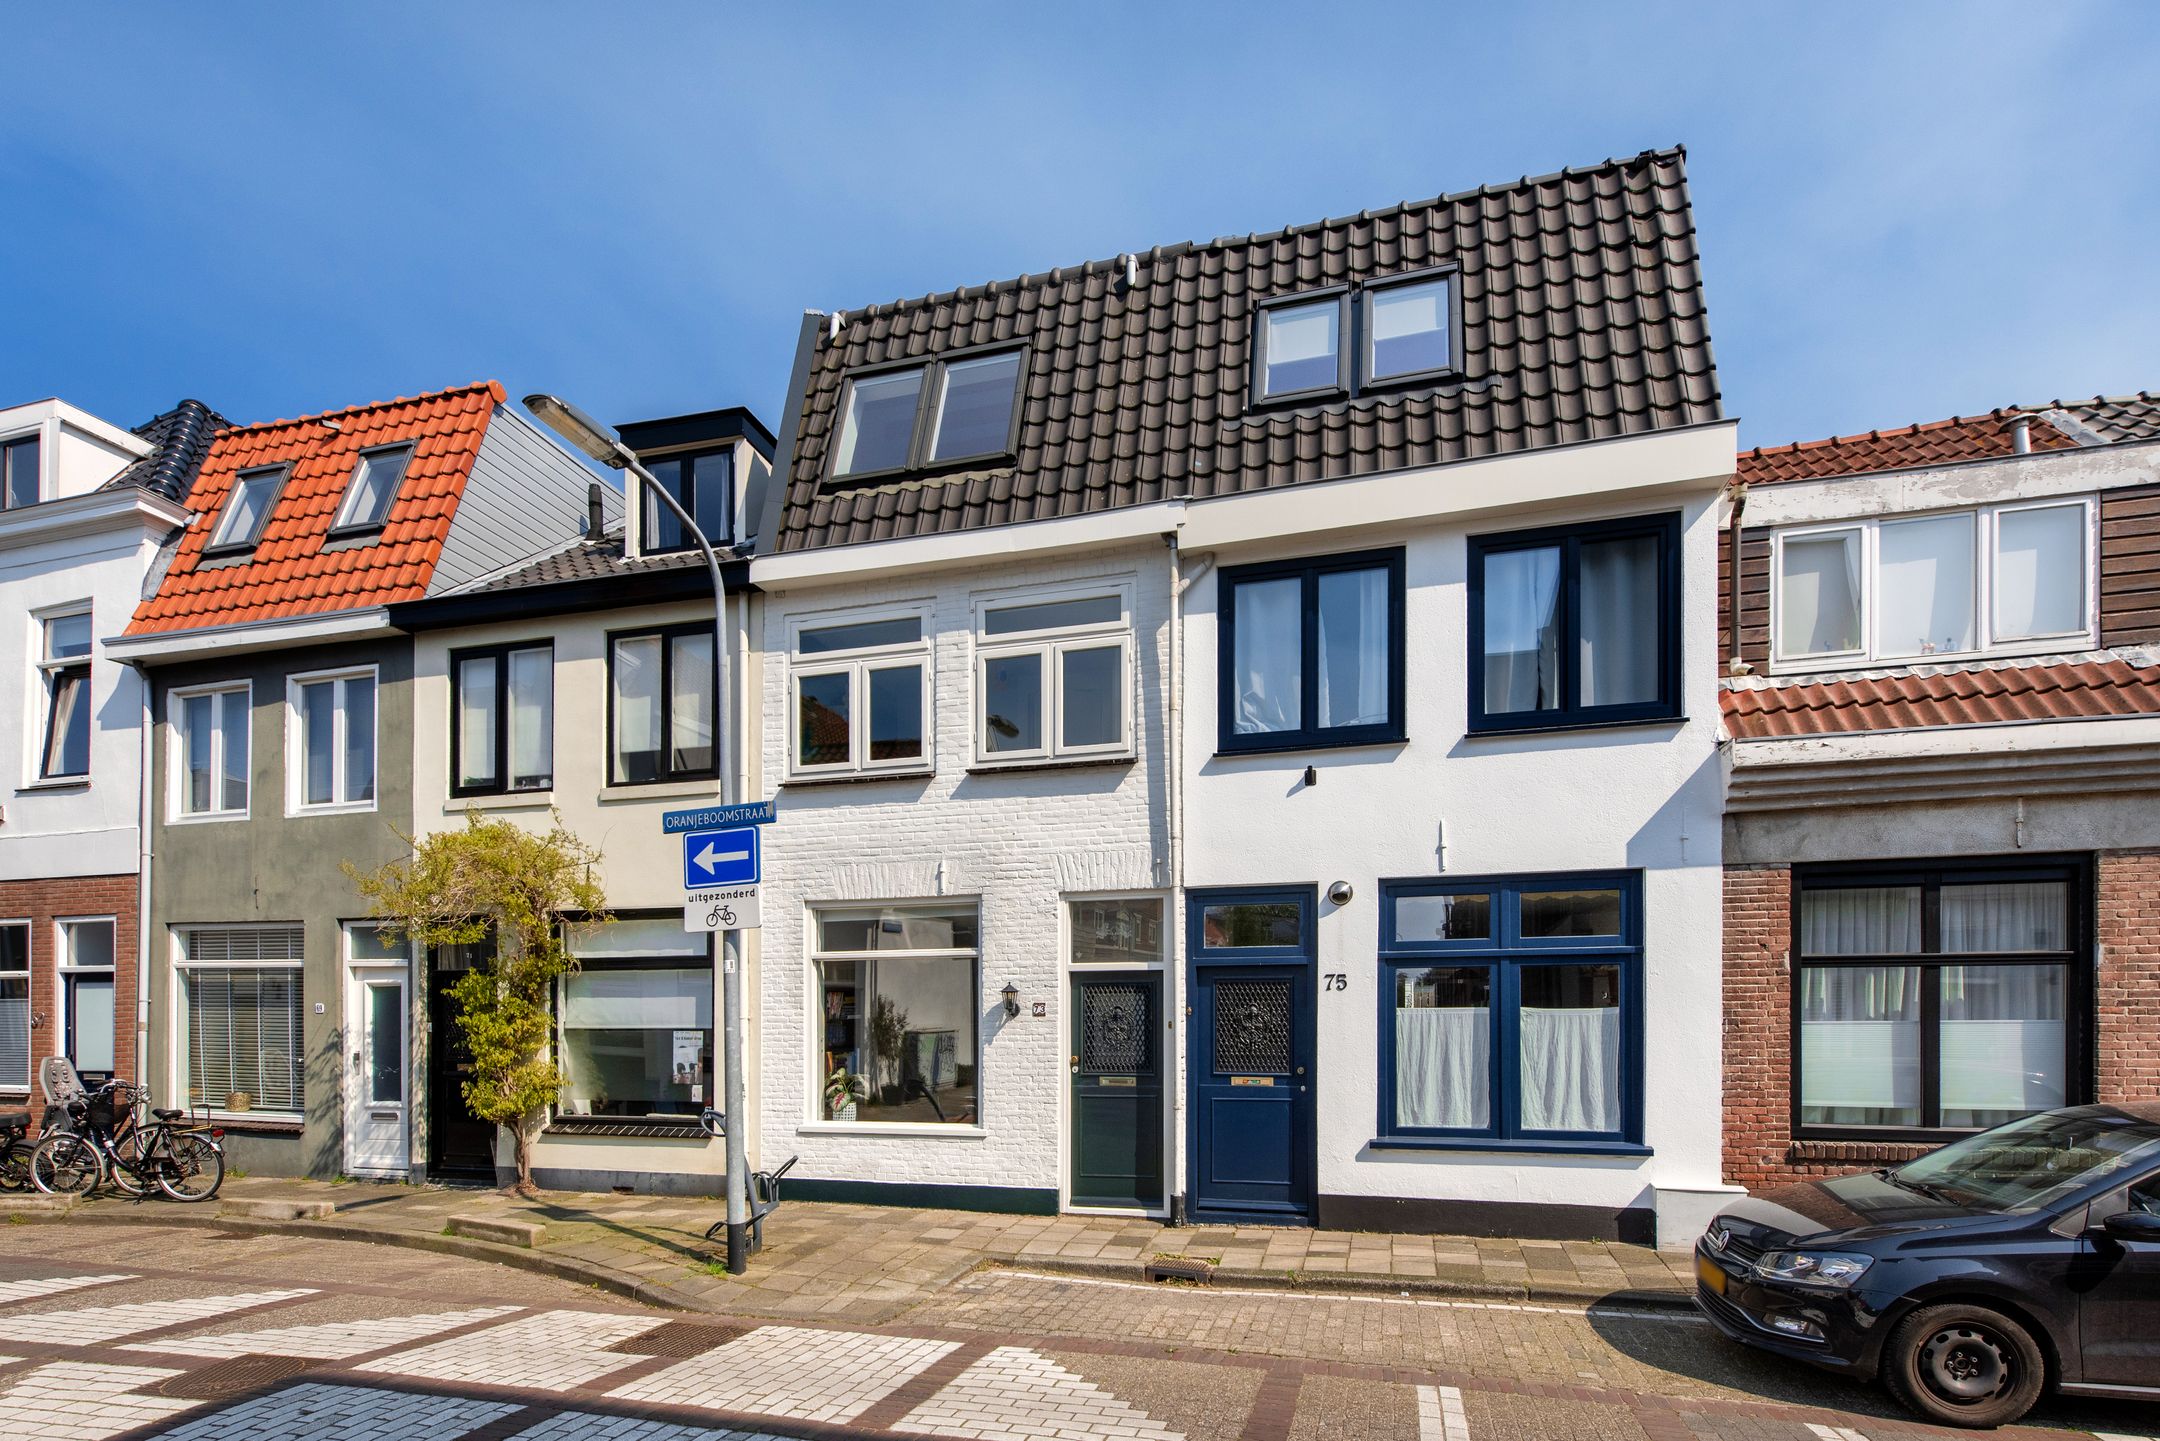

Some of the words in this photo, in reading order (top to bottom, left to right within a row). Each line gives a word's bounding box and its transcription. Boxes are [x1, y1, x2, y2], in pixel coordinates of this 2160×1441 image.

[666, 806, 772, 829] ORANJEBOOMSTRAAT
[688, 888, 755, 904] uitgezonderd
[1323, 973, 1347, 991] 75
[1034, 1005, 1046, 1013] 73
